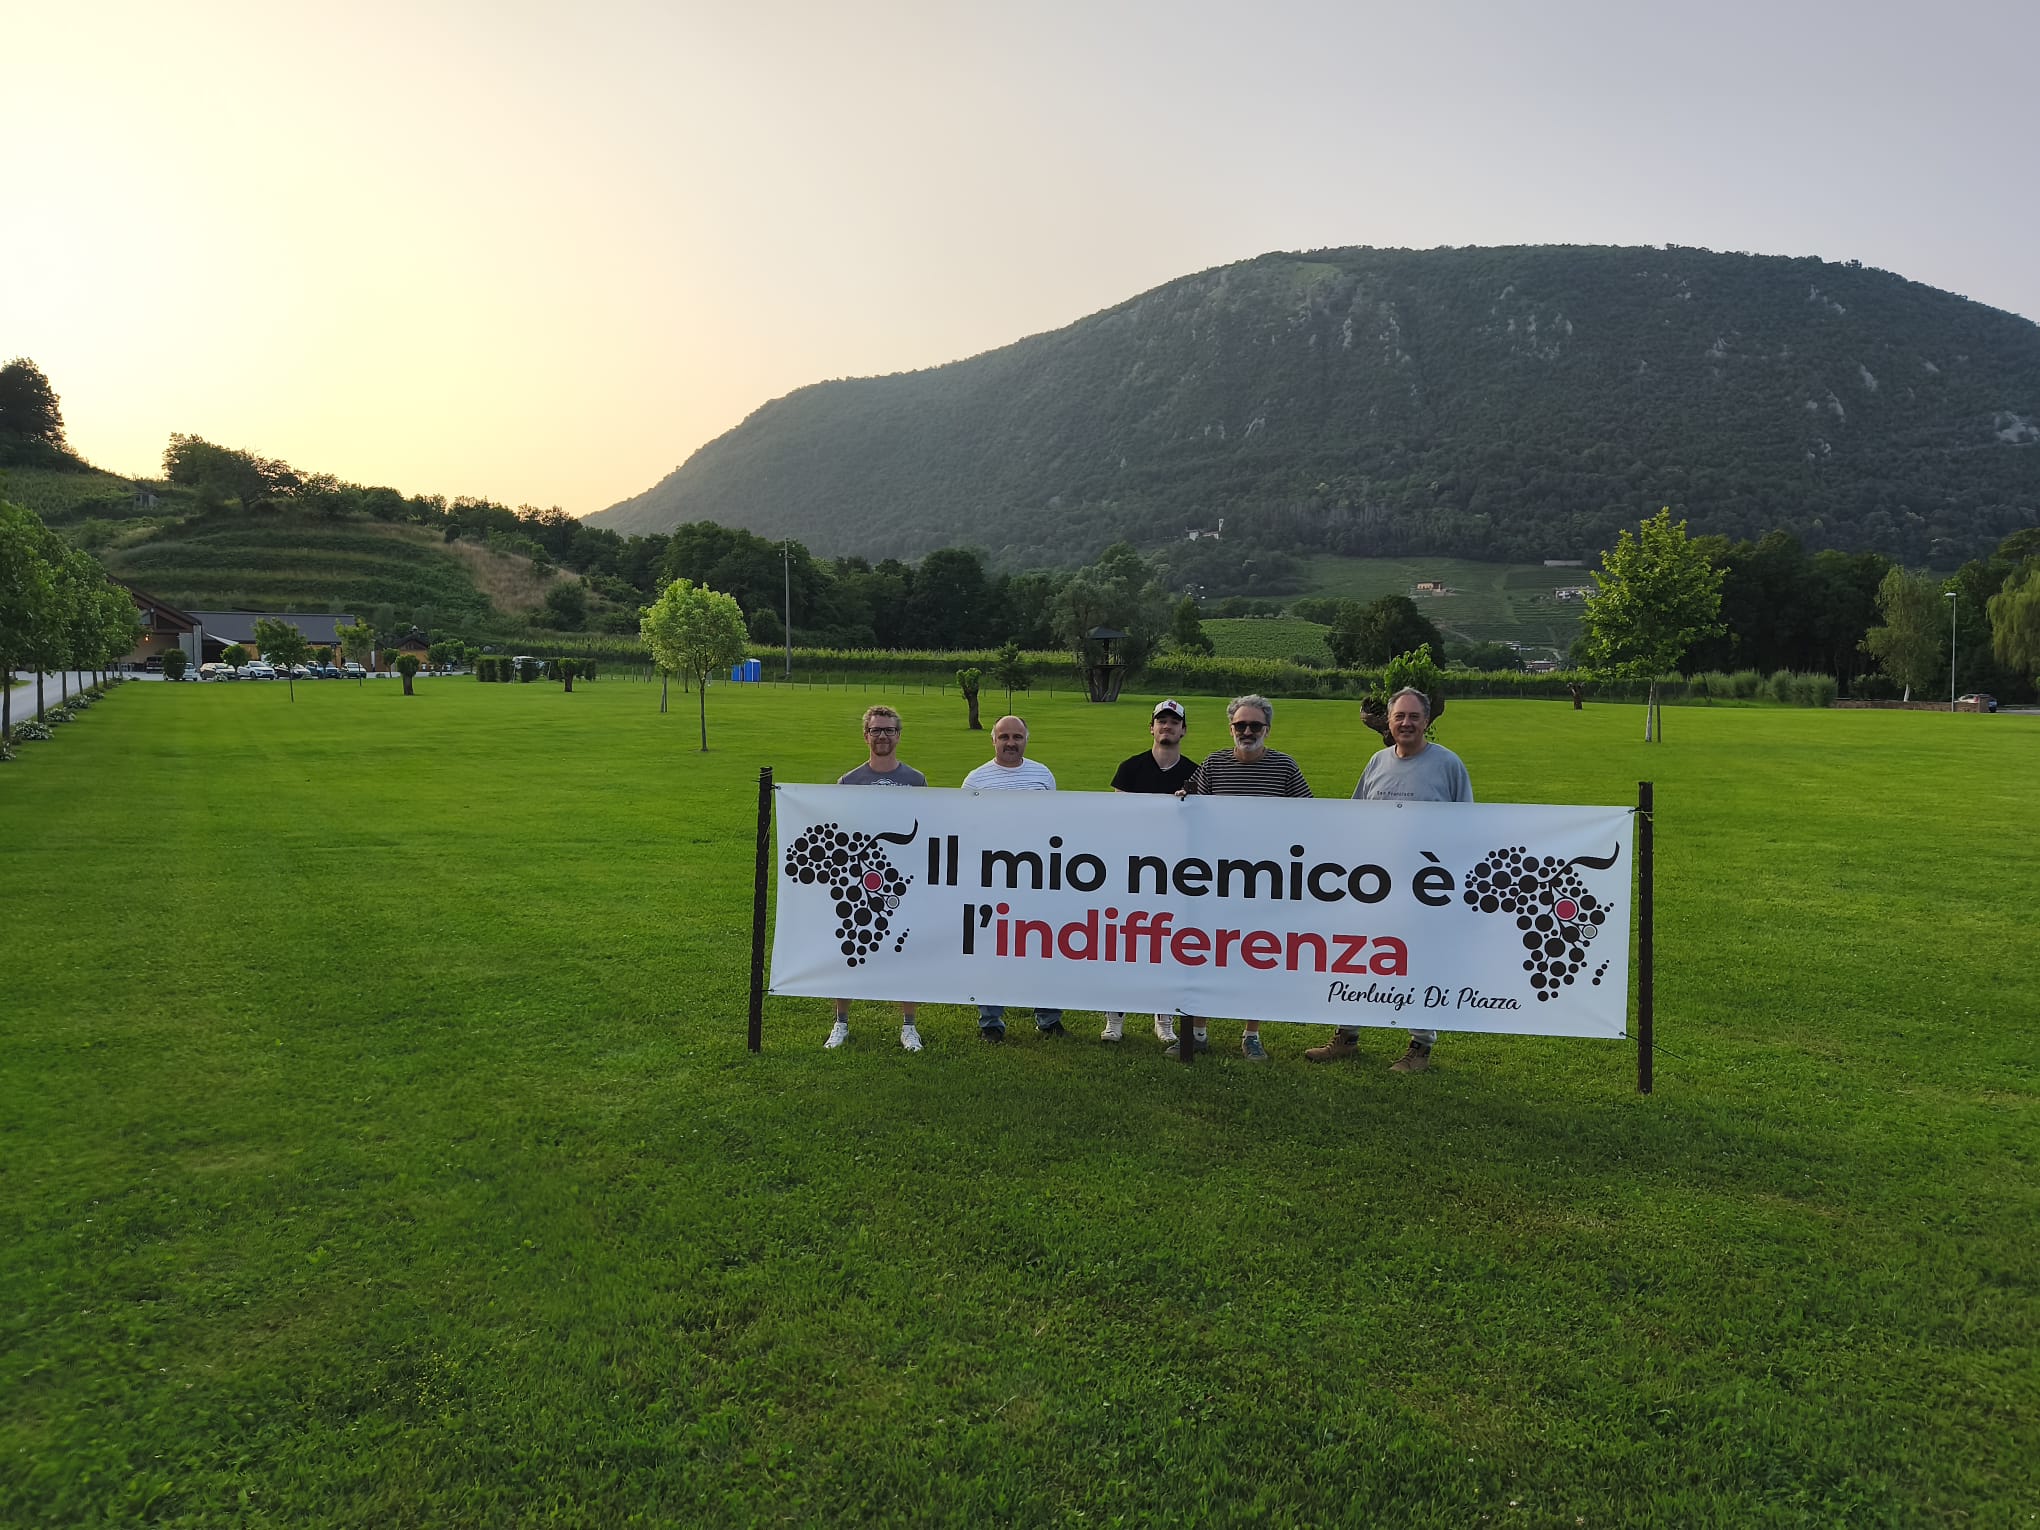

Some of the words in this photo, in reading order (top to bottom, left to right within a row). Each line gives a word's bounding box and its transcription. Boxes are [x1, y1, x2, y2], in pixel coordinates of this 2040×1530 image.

[927, 834, 959, 886] Il
[980, 835, 1107, 893] mio
[1127, 844, 1392, 904] nemico
[1411, 850, 1456, 907] è
[1327, 980, 1416, 1012] Pierluigi
[1423, 985, 1450, 1009] Di
[1456, 986, 1522, 1011] Piazza
